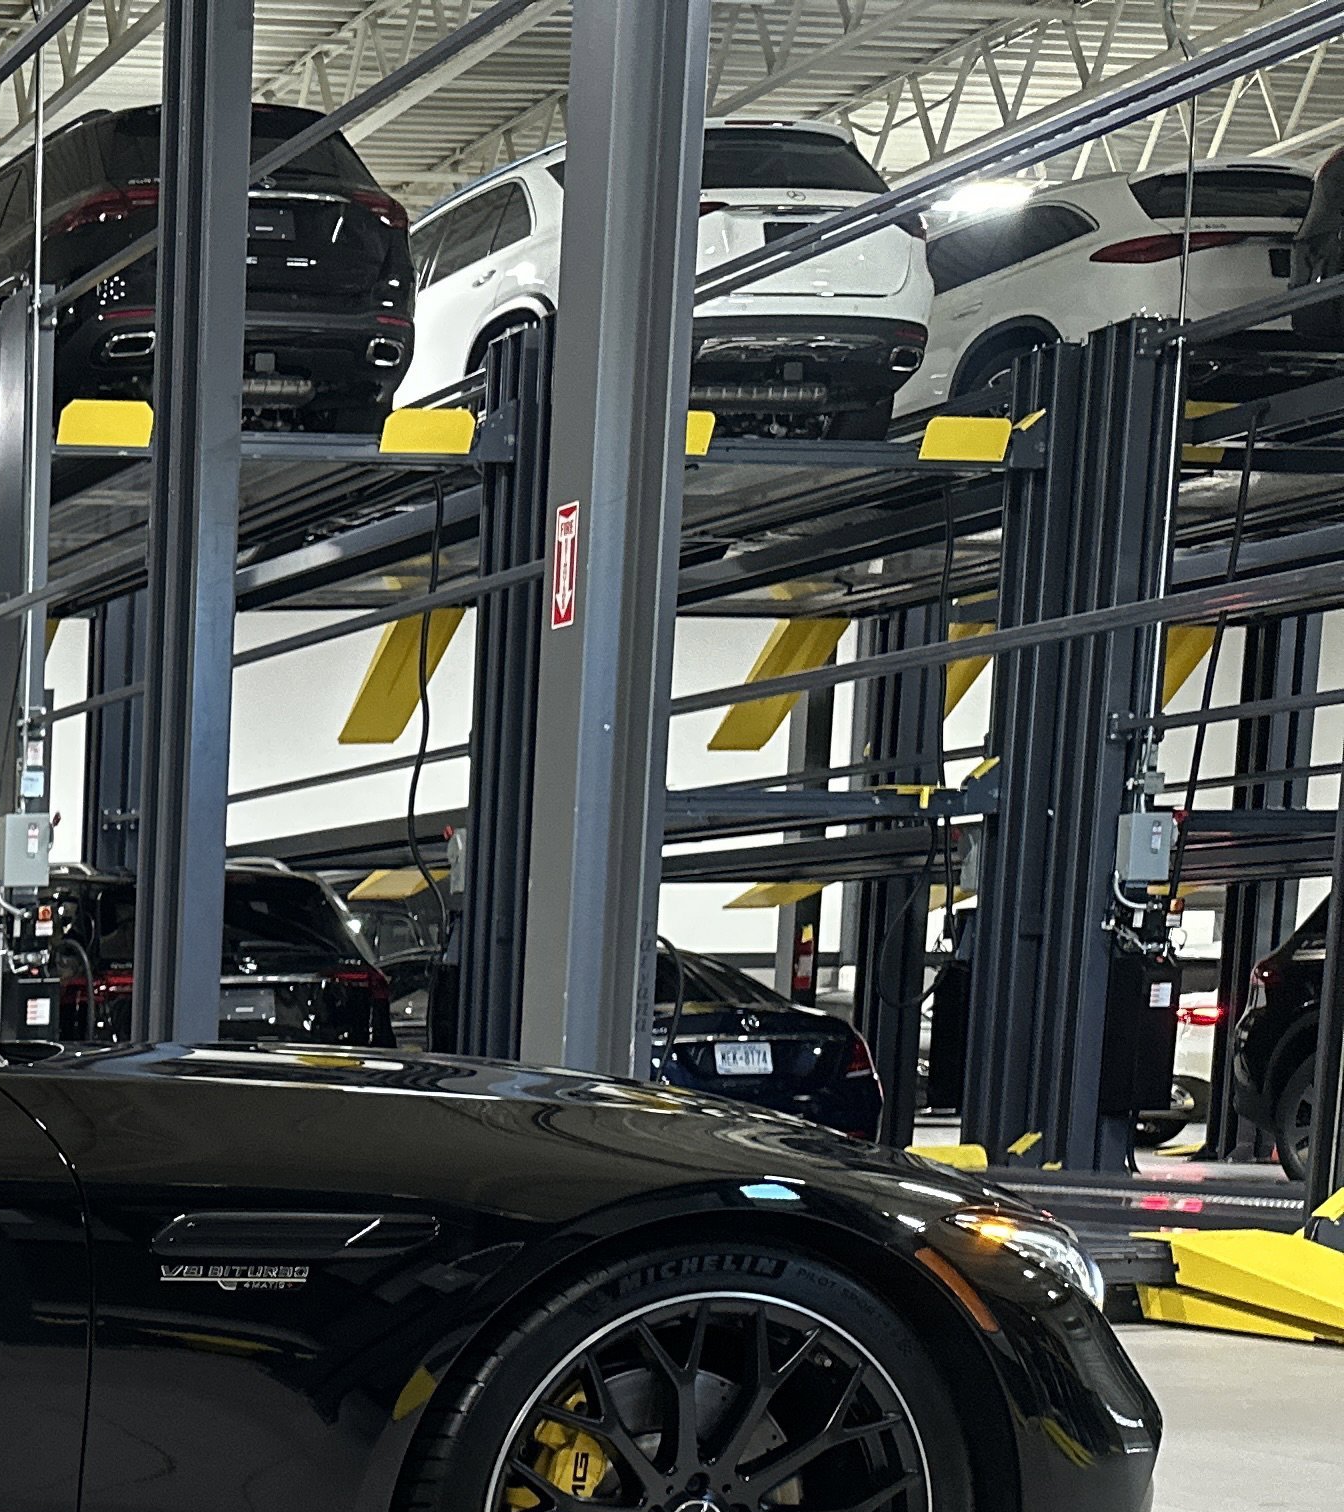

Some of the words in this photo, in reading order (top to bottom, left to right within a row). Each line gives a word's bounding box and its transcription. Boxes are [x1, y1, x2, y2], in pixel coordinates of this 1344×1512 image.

[160, 1264, 204, 1277] V8
[208, 1265, 310, 1278] BITURBO
[619, 1255, 778, 1295] MICHELIN
